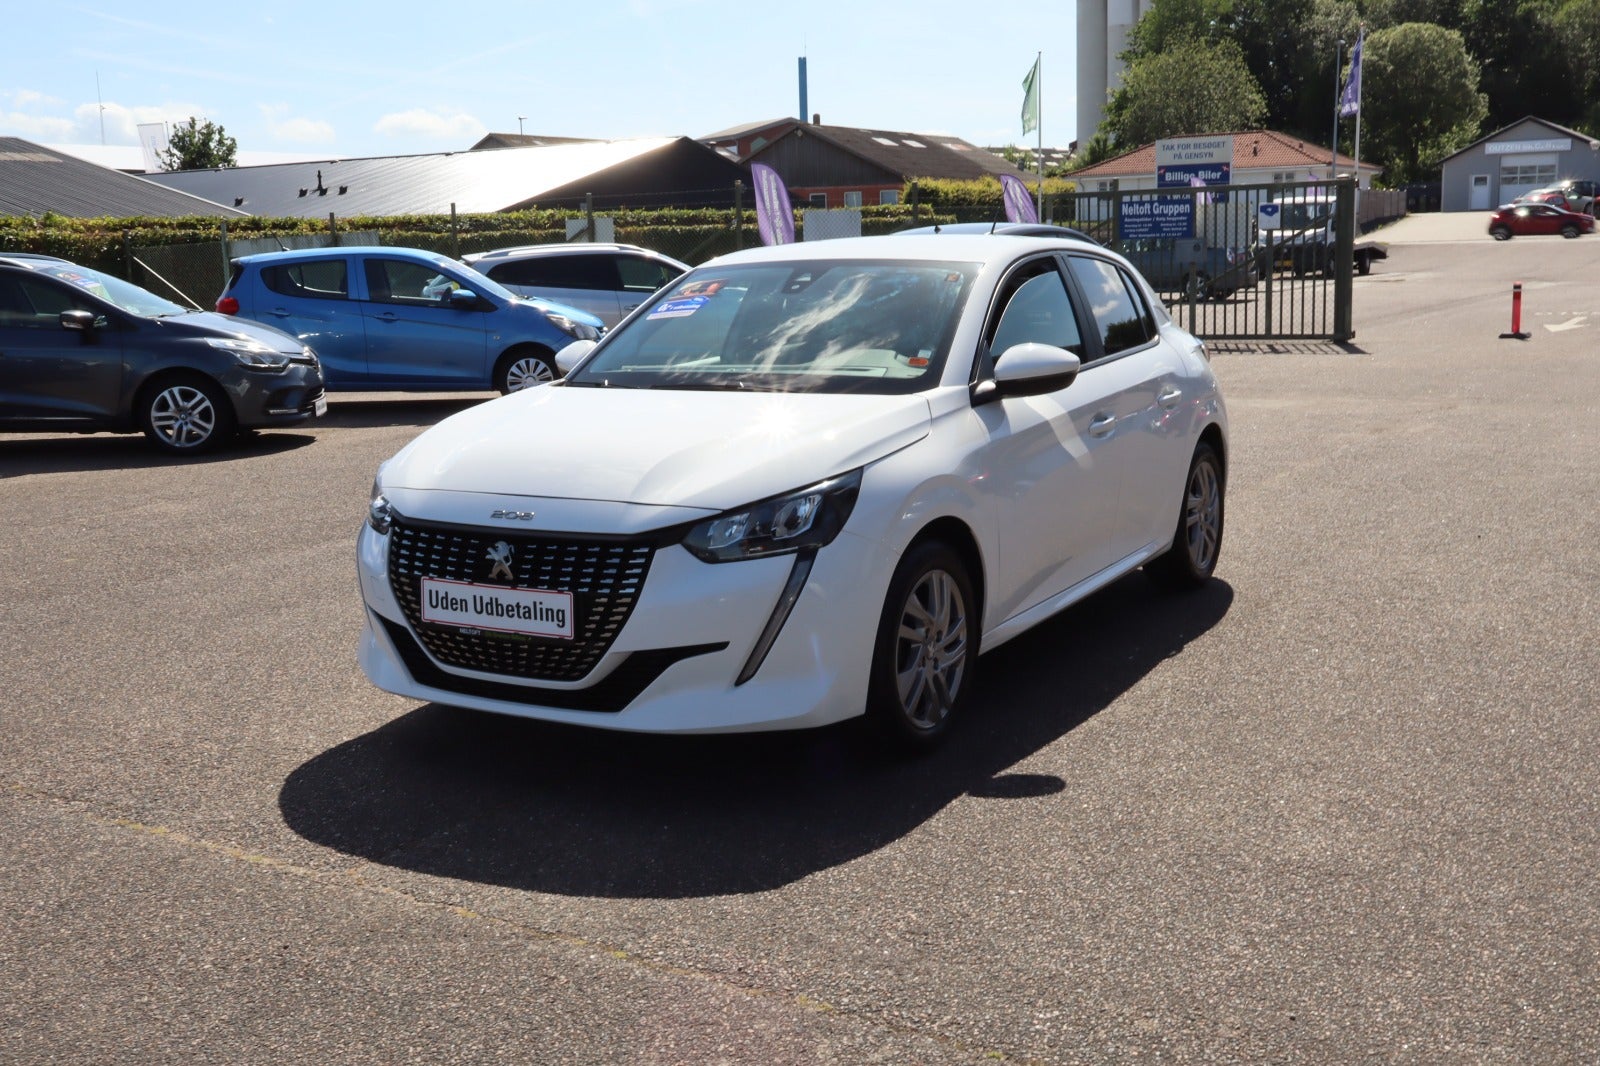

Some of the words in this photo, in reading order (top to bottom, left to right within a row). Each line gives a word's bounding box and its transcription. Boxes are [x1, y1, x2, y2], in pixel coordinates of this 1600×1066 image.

[1177, 143, 1191, 151] FOR
[1193, 141, 1226, 150] BESØGET
[1184, 152, 1214, 160] GENSYN
[1165, 171, 1196, 183] Billige
[1198, 170, 1222, 180] Biler
[1121, 203, 1151, 216] Neltoft
[1152, 202, 1191, 216] Gruppen
[490, 510, 535, 521] 208
[428, 589, 468, 613] Uden
[473, 594, 566, 629] Udbetaling
